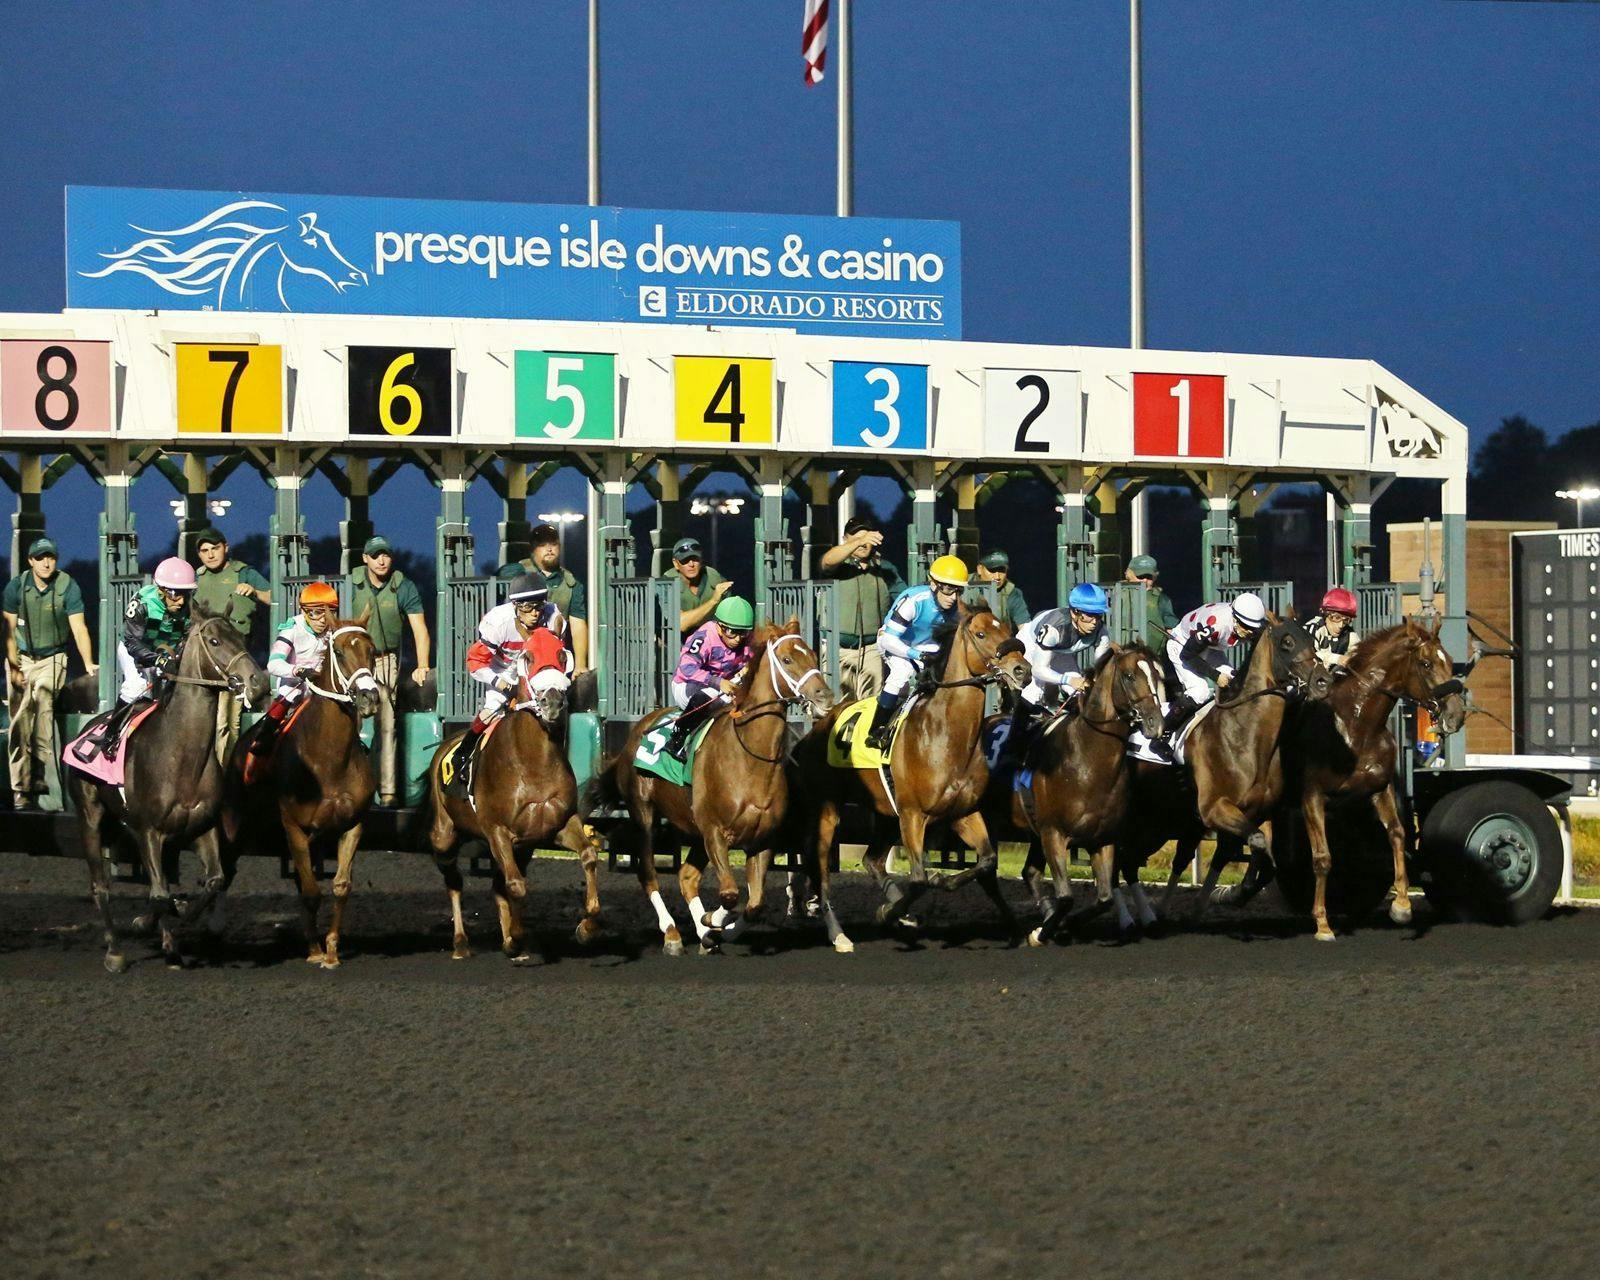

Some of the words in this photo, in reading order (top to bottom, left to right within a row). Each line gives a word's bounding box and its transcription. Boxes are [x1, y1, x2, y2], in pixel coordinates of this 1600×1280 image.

[376, 232, 551, 278] presque
[560, 220, 627, 270] isle
[636, 225, 771, 277] downs
[778, 235, 813, 277] &
[818, 238, 943, 282] casino
[676, 292, 825, 316] ELDORADO
[832, 298, 943, 321] RESORTS
[36, 346, 78, 430] 8
[208, 350, 249, 432] 7
[379, 353, 422, 436] 6
[542, 357, 586, 439] 5
[703, 364, 745, 443] 4
[859, 367, 901, 447] 3
[1015, 375, 1049, 452] 2
[1170, 379, 1190, 456] 1
[1558, 533, 1600, 557] TIMES
[126, 600, 138, 618] 8
[1196, 627, 1211, 641] 2
[689, 639, 703, 654] 5
[834, 712, 862, 760] 4
[985, 724, 1011, 769] 3
